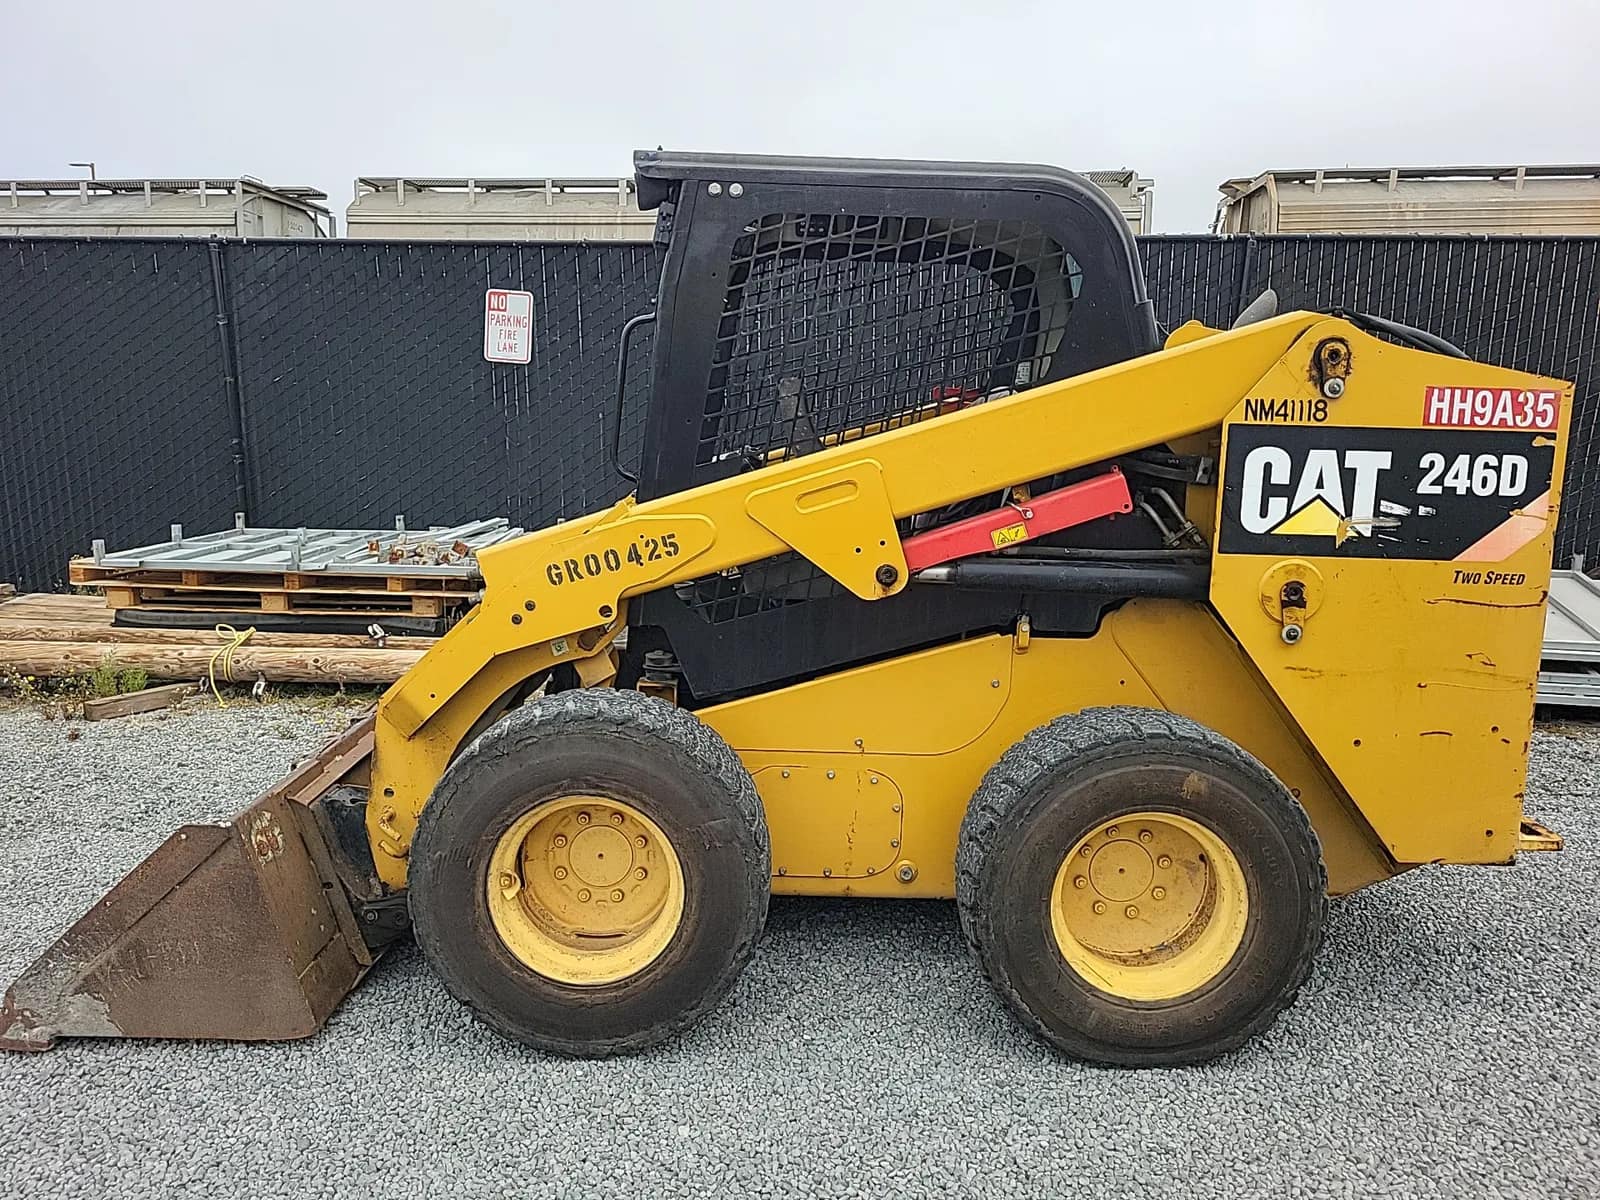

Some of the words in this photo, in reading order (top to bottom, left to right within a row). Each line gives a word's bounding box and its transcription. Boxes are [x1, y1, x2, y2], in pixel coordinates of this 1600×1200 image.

[490, 294, 506, 309] NO
[490, 313, 528, 328] PARKING
[498, 329, 518, 340] FIRE
[497, 342, 518, 353] LANE
[1244, 398, 1328, 422] NM41118
[1428, 388, 1555, 428] HH9A35
[1416, 452, 1528, 497] 246D
[1240, 446, 1392, 537] CAT
